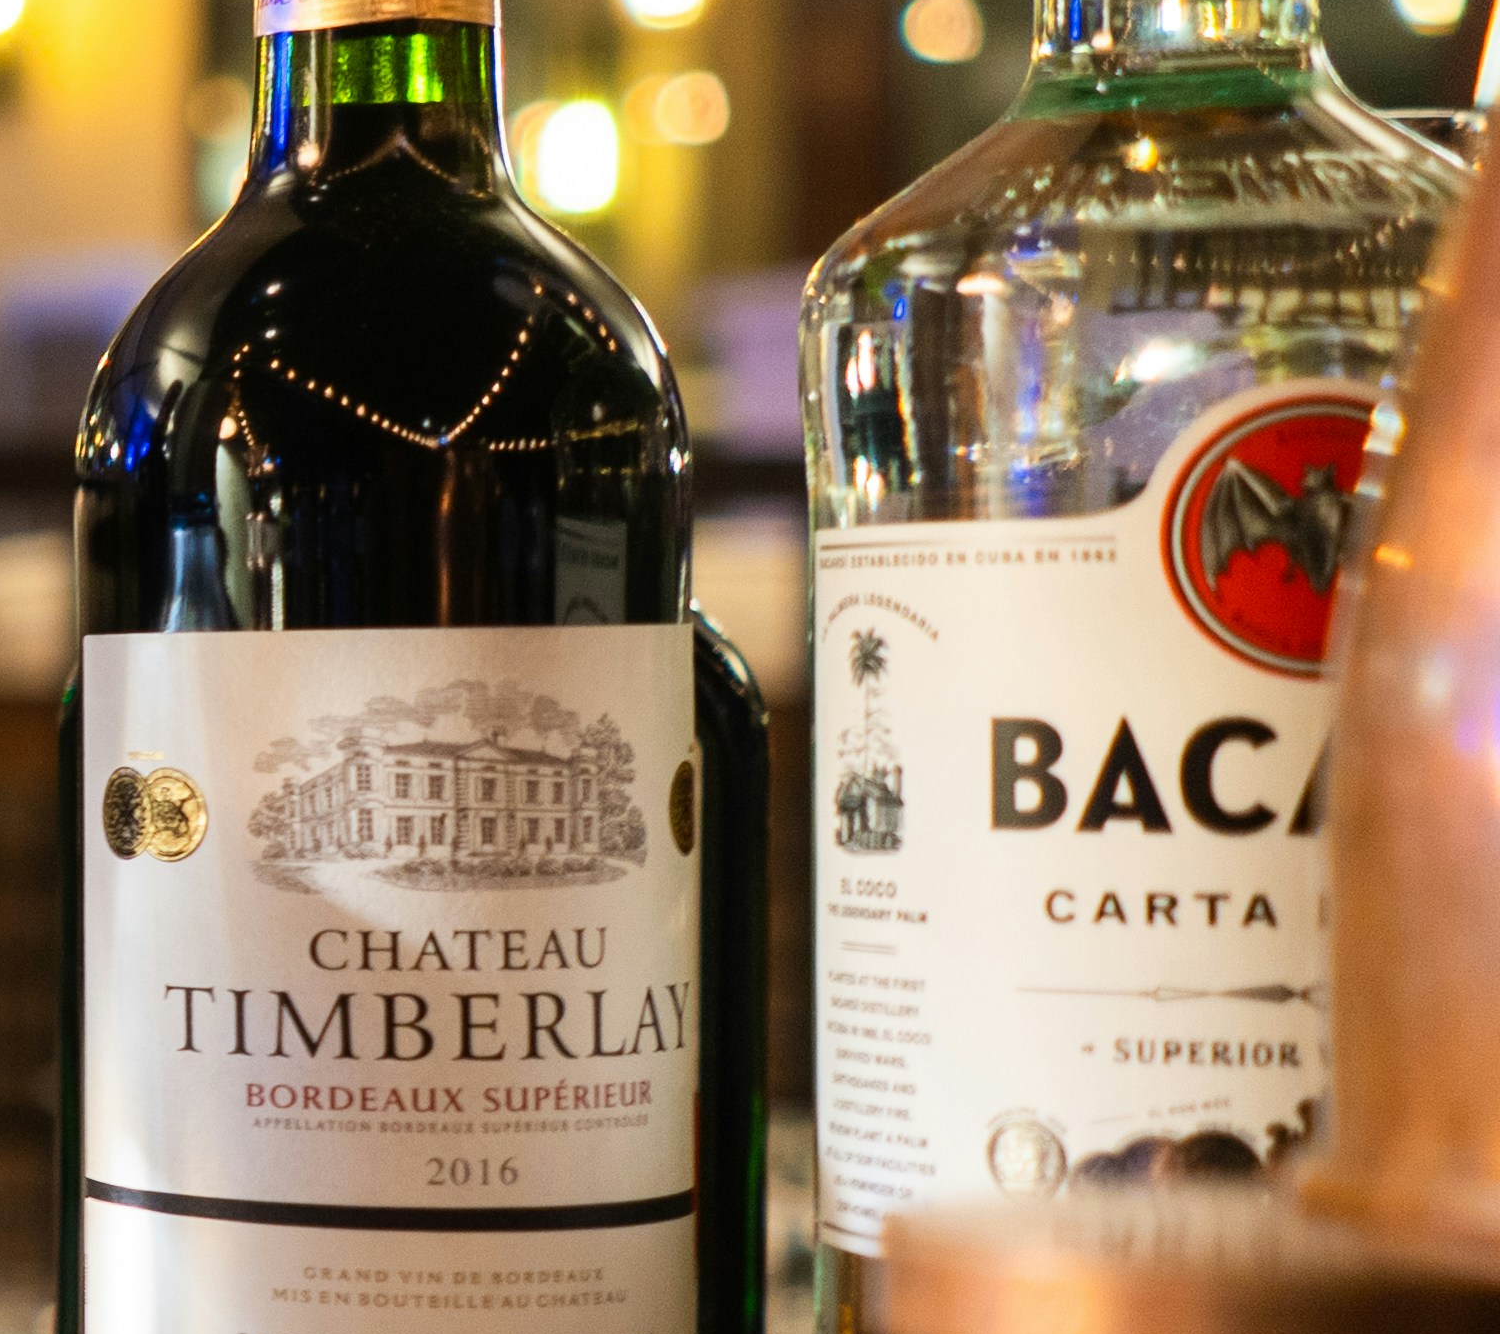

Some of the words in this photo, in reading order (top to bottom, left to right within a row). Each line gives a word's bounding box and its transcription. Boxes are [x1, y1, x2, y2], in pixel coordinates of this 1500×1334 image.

[1044, 889, 1279, 929] CARTA
[308, 926, 608, 973] CHATEAU
[162, 980, 691, 1064] TIMBERLAY
[1113, 1038, 1301, 1068] SUPERIOR
[245, 1082, 465, 1115] BORDEAUX
[483, 1078, 653, 1114] SUPÉRIEUR
[251, 1115, 372, 1134] APPELLATION
[379, 1119, 474, 1135] BORDEAUX
[425, 1155, 521, 1187] 2016
[302, 1266, 390, 1284] GRAND
[399, 1269, 442, 1286] VIN
[452, 1270, 482, 1286] DE
[491, 1267, 604, 1286] BORDEAUX
[270, 1287, 313, 1305] MIS
[318, 1291, 351, 1307] EN
[357, 1292, 495, 1310] BOUTEILLE
[501, 1294, 530, 1309] AU
[534, 1287, 629, 1309] CHATEAU
